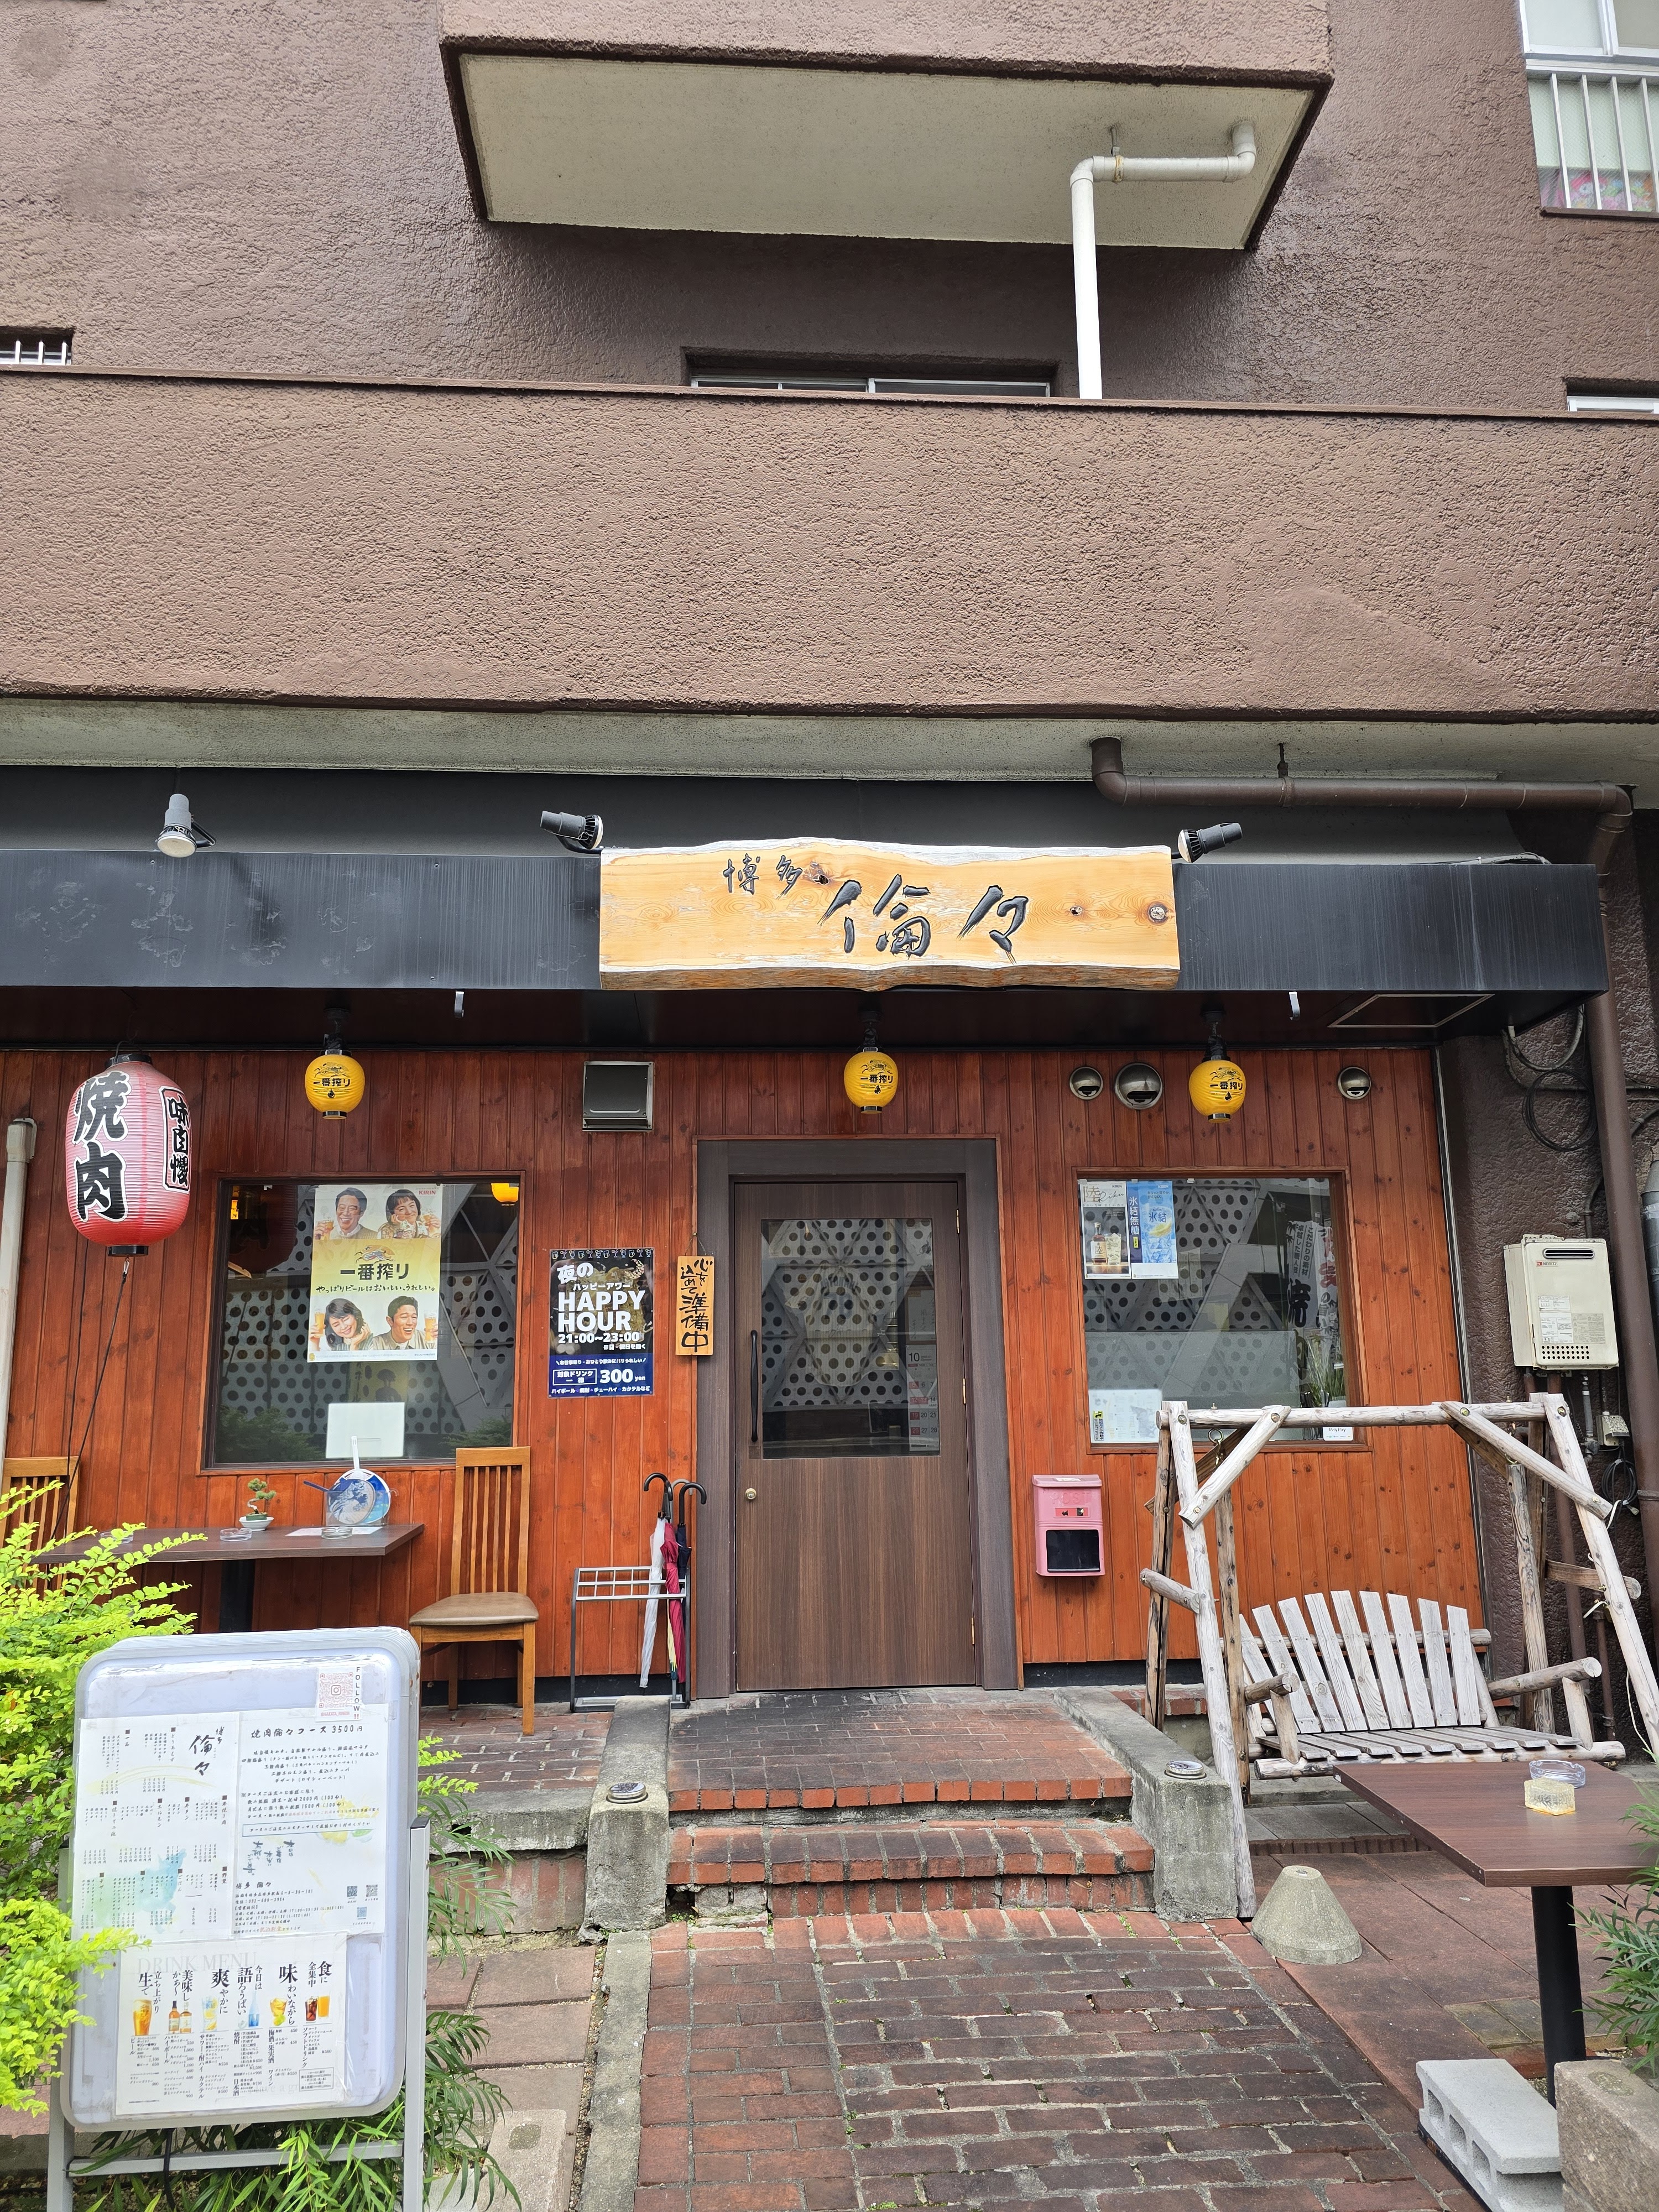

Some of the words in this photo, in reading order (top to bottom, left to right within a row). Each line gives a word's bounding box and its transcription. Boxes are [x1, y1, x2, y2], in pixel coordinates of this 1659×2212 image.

[723, 853, 805, 897] 博多
[313, 1078, 350, 1087] 一番搾り
[860, 1074, 893, 1083] 一番搾り
[1210, 1081, 1243, 1090] 一番搾り
[74, 1071, 129, 1220] 焼肉
[1129, 1197, 1139, 1235] 氷結無糖
[1149, 1212, 1167, 1223] 氷結
[1301, 1227, 1313, 1276] こだわりの素材
[340, 1263, 409, 1280] 一番搾り
[556, 1262, 594, 1284] 夜の
[693, 1258, 713, 1286] 心を
[316, 1284, 435, 1293] やっぱりビールはおいしい、うれしい。
[573, 1282, 631, 1291] ハッピーアワー
[558, 1290, 646, 1312] HAPPY
[558, 1311, 631, 1332] HOUR
[679, 1292, 709, 1353] 準備中
[909, 1353, 920, 1361] 10
[600, 1369, 633, 1384] 300
[332, 1725, 363, 1733] 3500円
[138, 1956, 194, 1974] DRINK
[203, 1952, 256, 1972] MENU
[317, 1961, 332, 1984] 食に
[138, 1972, 153, 1995] 生て
[153, 1971, 161, 2014] 立ち上がり
[181, 1970, 194, 2001] 美味し
[211, 1969, 230, 2014] 爽やかに
[237, 1966, 253, 2015] 語ろうばい
[279, 1964, 298, 2025] 味わいながら
